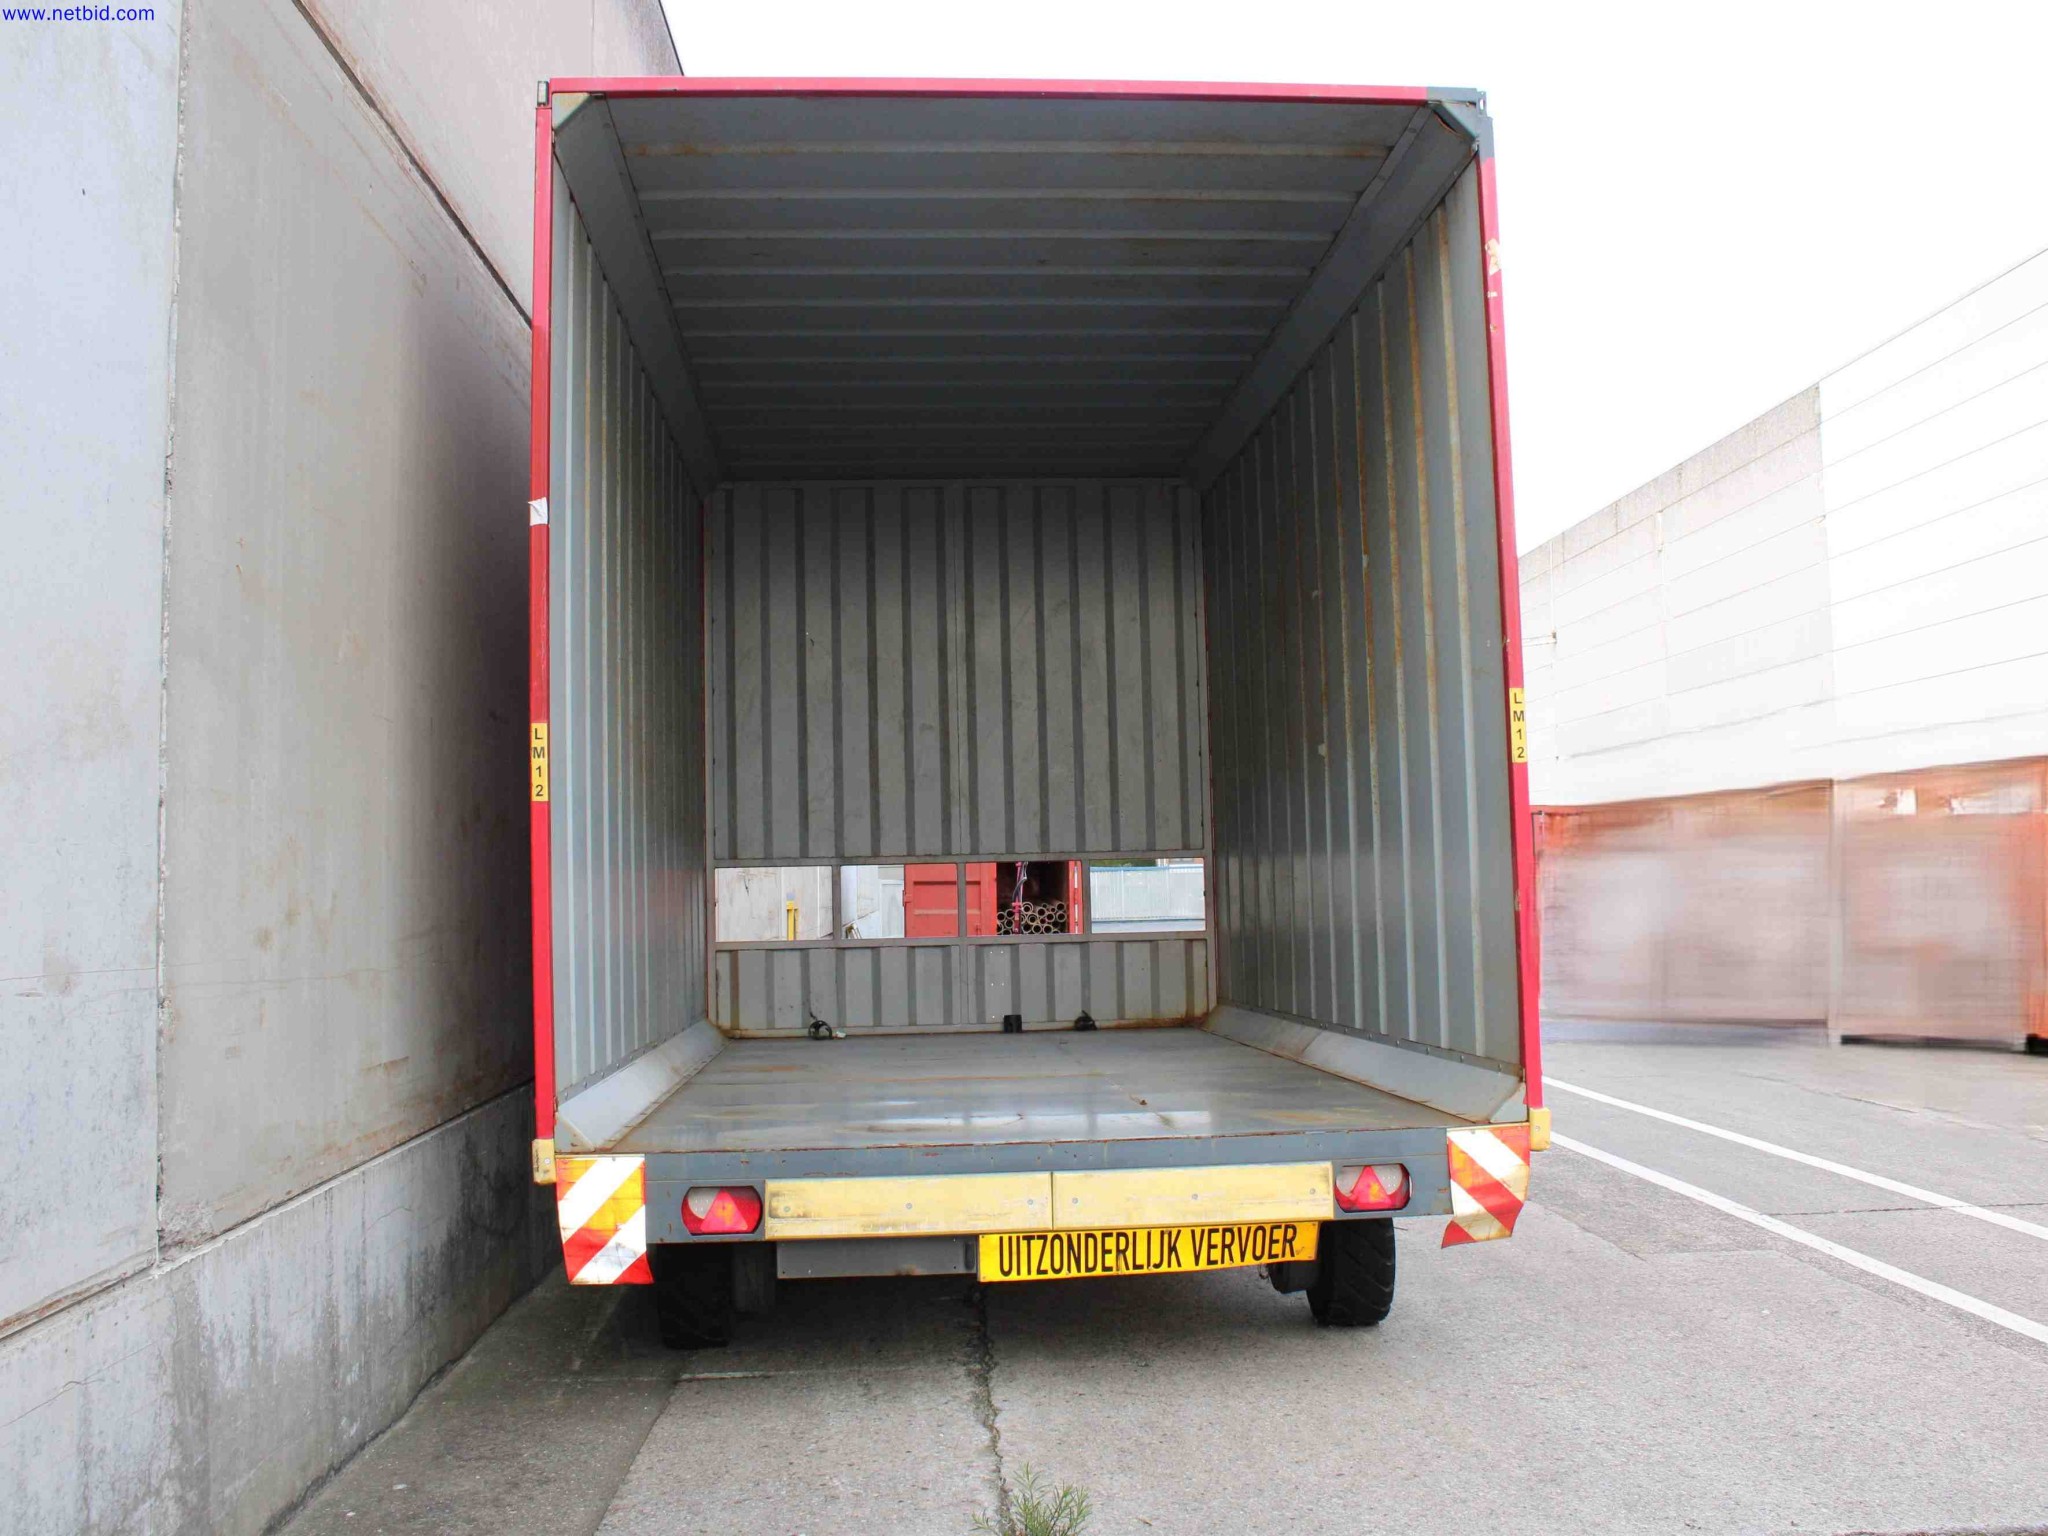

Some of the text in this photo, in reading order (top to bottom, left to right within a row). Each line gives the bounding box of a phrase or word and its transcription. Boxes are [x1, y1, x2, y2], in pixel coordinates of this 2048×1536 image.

[1513, 692, 1525, 758] LM12
[532, 727, 545, 797] LM12
[998, 1223, 1298, 1277] UITZONDERLIJK VERVOER
